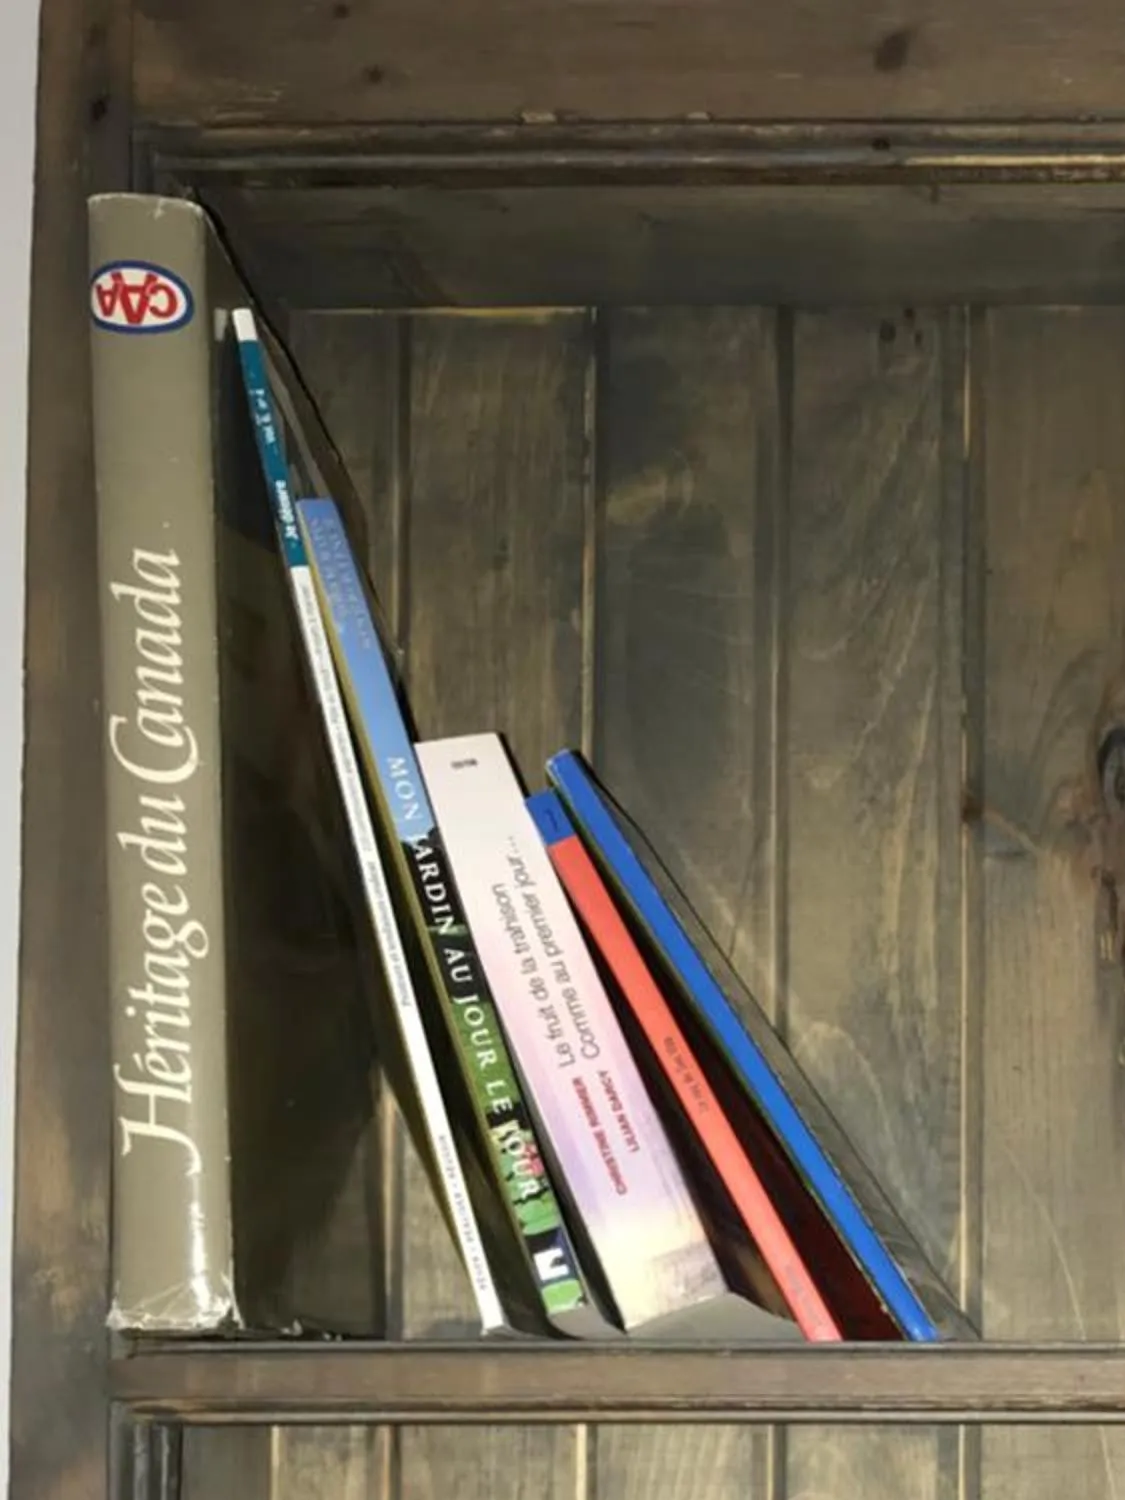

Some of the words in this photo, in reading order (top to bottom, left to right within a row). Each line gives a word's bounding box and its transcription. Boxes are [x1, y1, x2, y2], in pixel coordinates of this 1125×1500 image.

[96, 270, 178, 325] CAA
[109, 547, 199, 785] Canada
[385, 753, 423, 822] MON
[118, 794, 189, 876] du
[405, 830, 459, 937] JARDIN
[488, 880, 530, 957] trahison
[520, 888, 562, 961] premier
[443, 943, 472, 984] AU
[516, 955, 538, 976] la
[524, 975, 550, 1003] de
[549, 959, 572, 986] au
[114, 883, 208, 1177] Héritage
[453, 990, 499, 1070] JOUR
[536, 1003, 566, 1042] fruit
[557, 984, 602, 1062] Comme
[551, 1040, 577, 1069] Le
[484, 1077, 513, 1115] LE
[596, 1066, 624, 1113] DARCY
